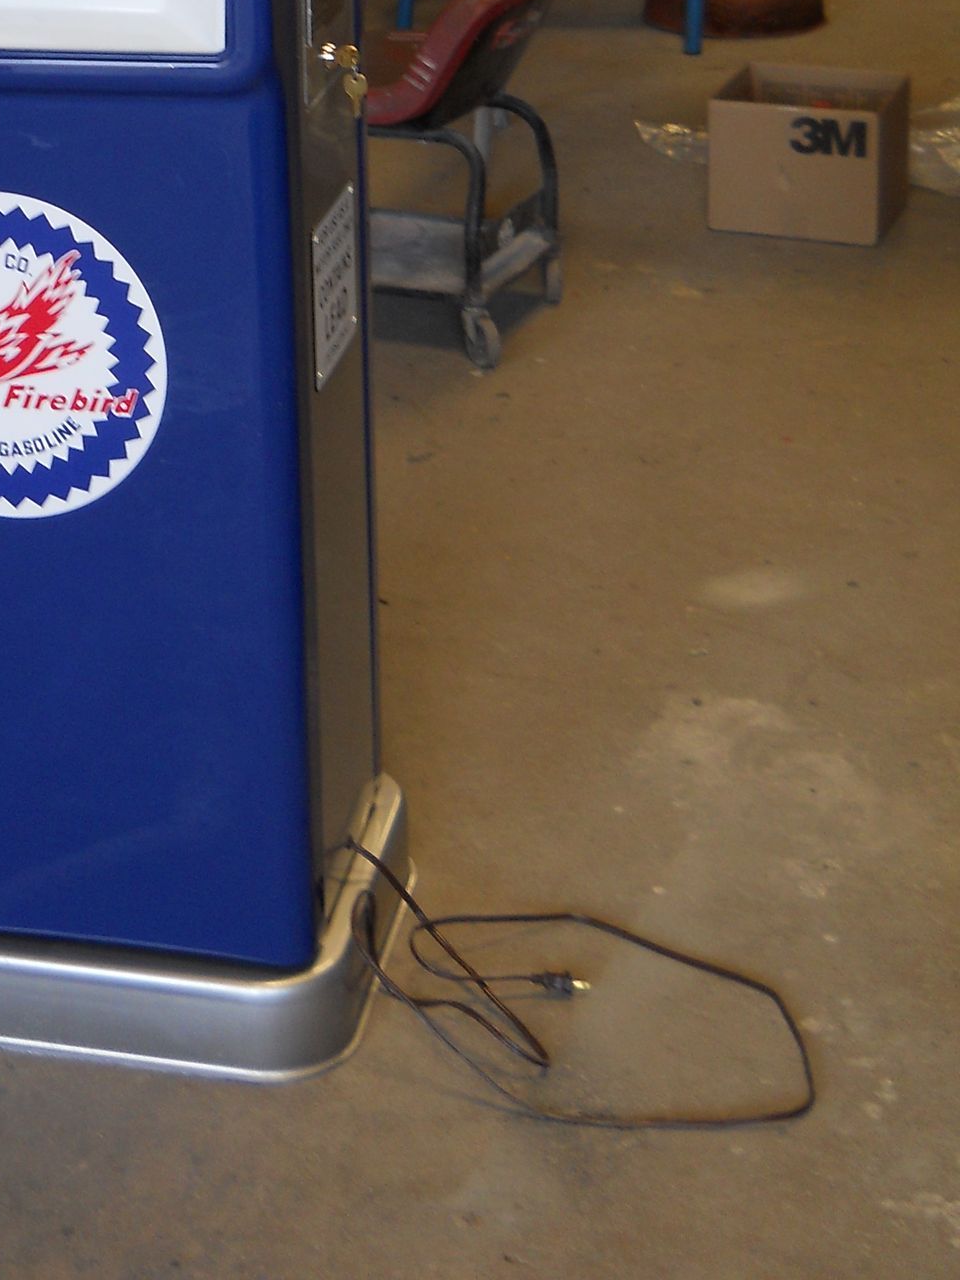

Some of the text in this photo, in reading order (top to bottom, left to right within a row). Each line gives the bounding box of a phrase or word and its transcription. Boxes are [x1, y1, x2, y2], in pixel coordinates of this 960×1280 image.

[790, 116, 868, 158] 3M
[4, 253, 33, 277] CO.
[3, 384, 140, 418] Firebird
